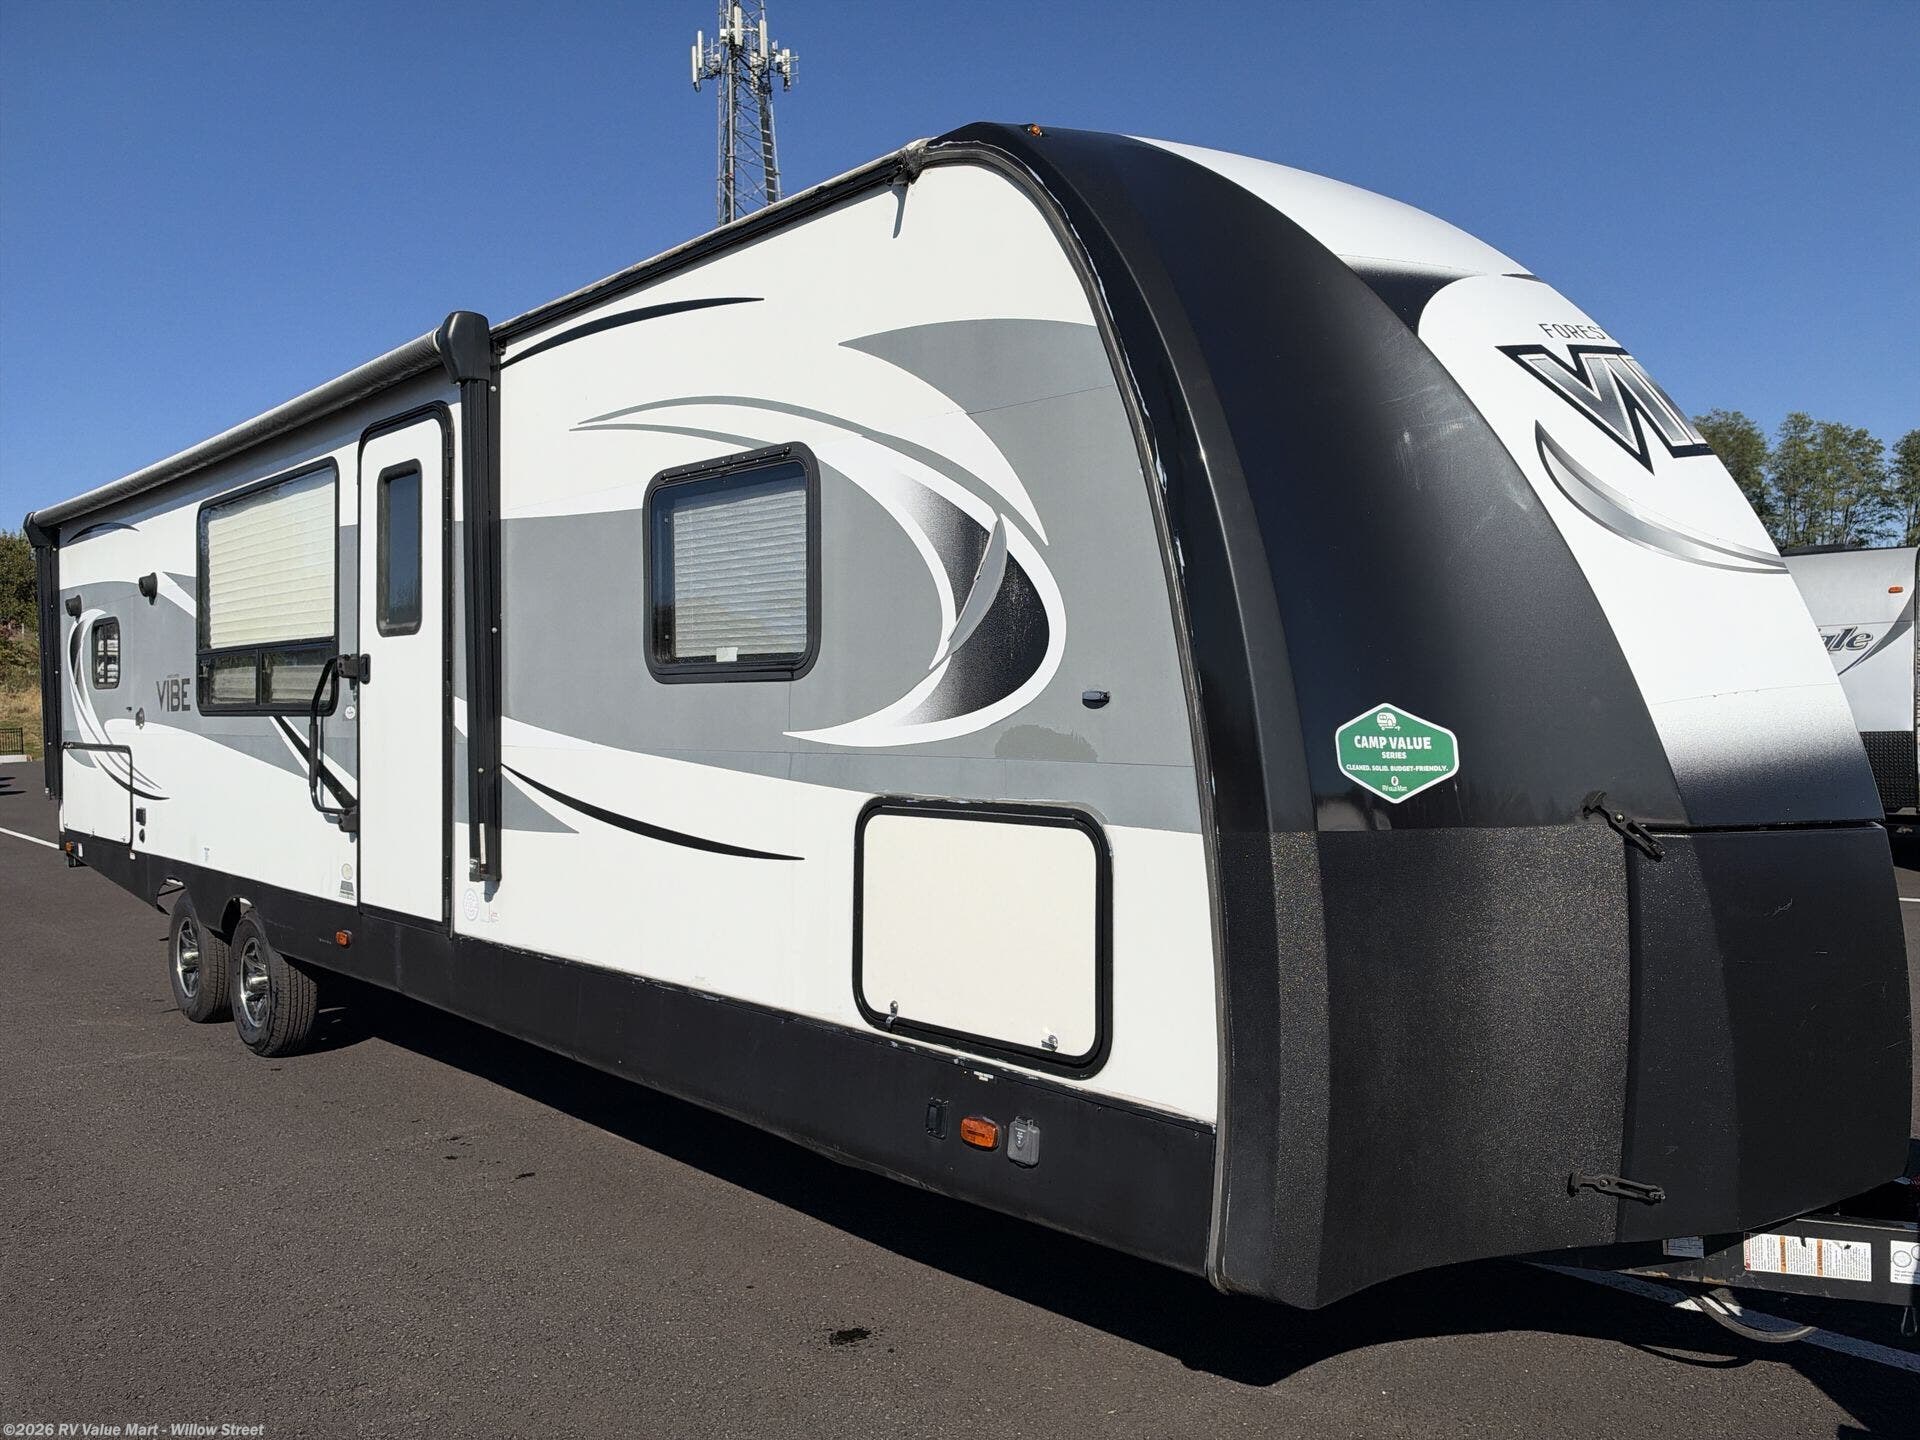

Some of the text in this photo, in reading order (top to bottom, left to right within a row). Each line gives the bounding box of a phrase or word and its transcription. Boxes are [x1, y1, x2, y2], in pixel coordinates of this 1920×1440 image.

[1538, 323, 1606, 340] FORES
[155, 677, 191, 712] VIBE
[1353, 735, 1432, 750] CAMP VALUE
[1381, 751, 1407, 760] SERIES
